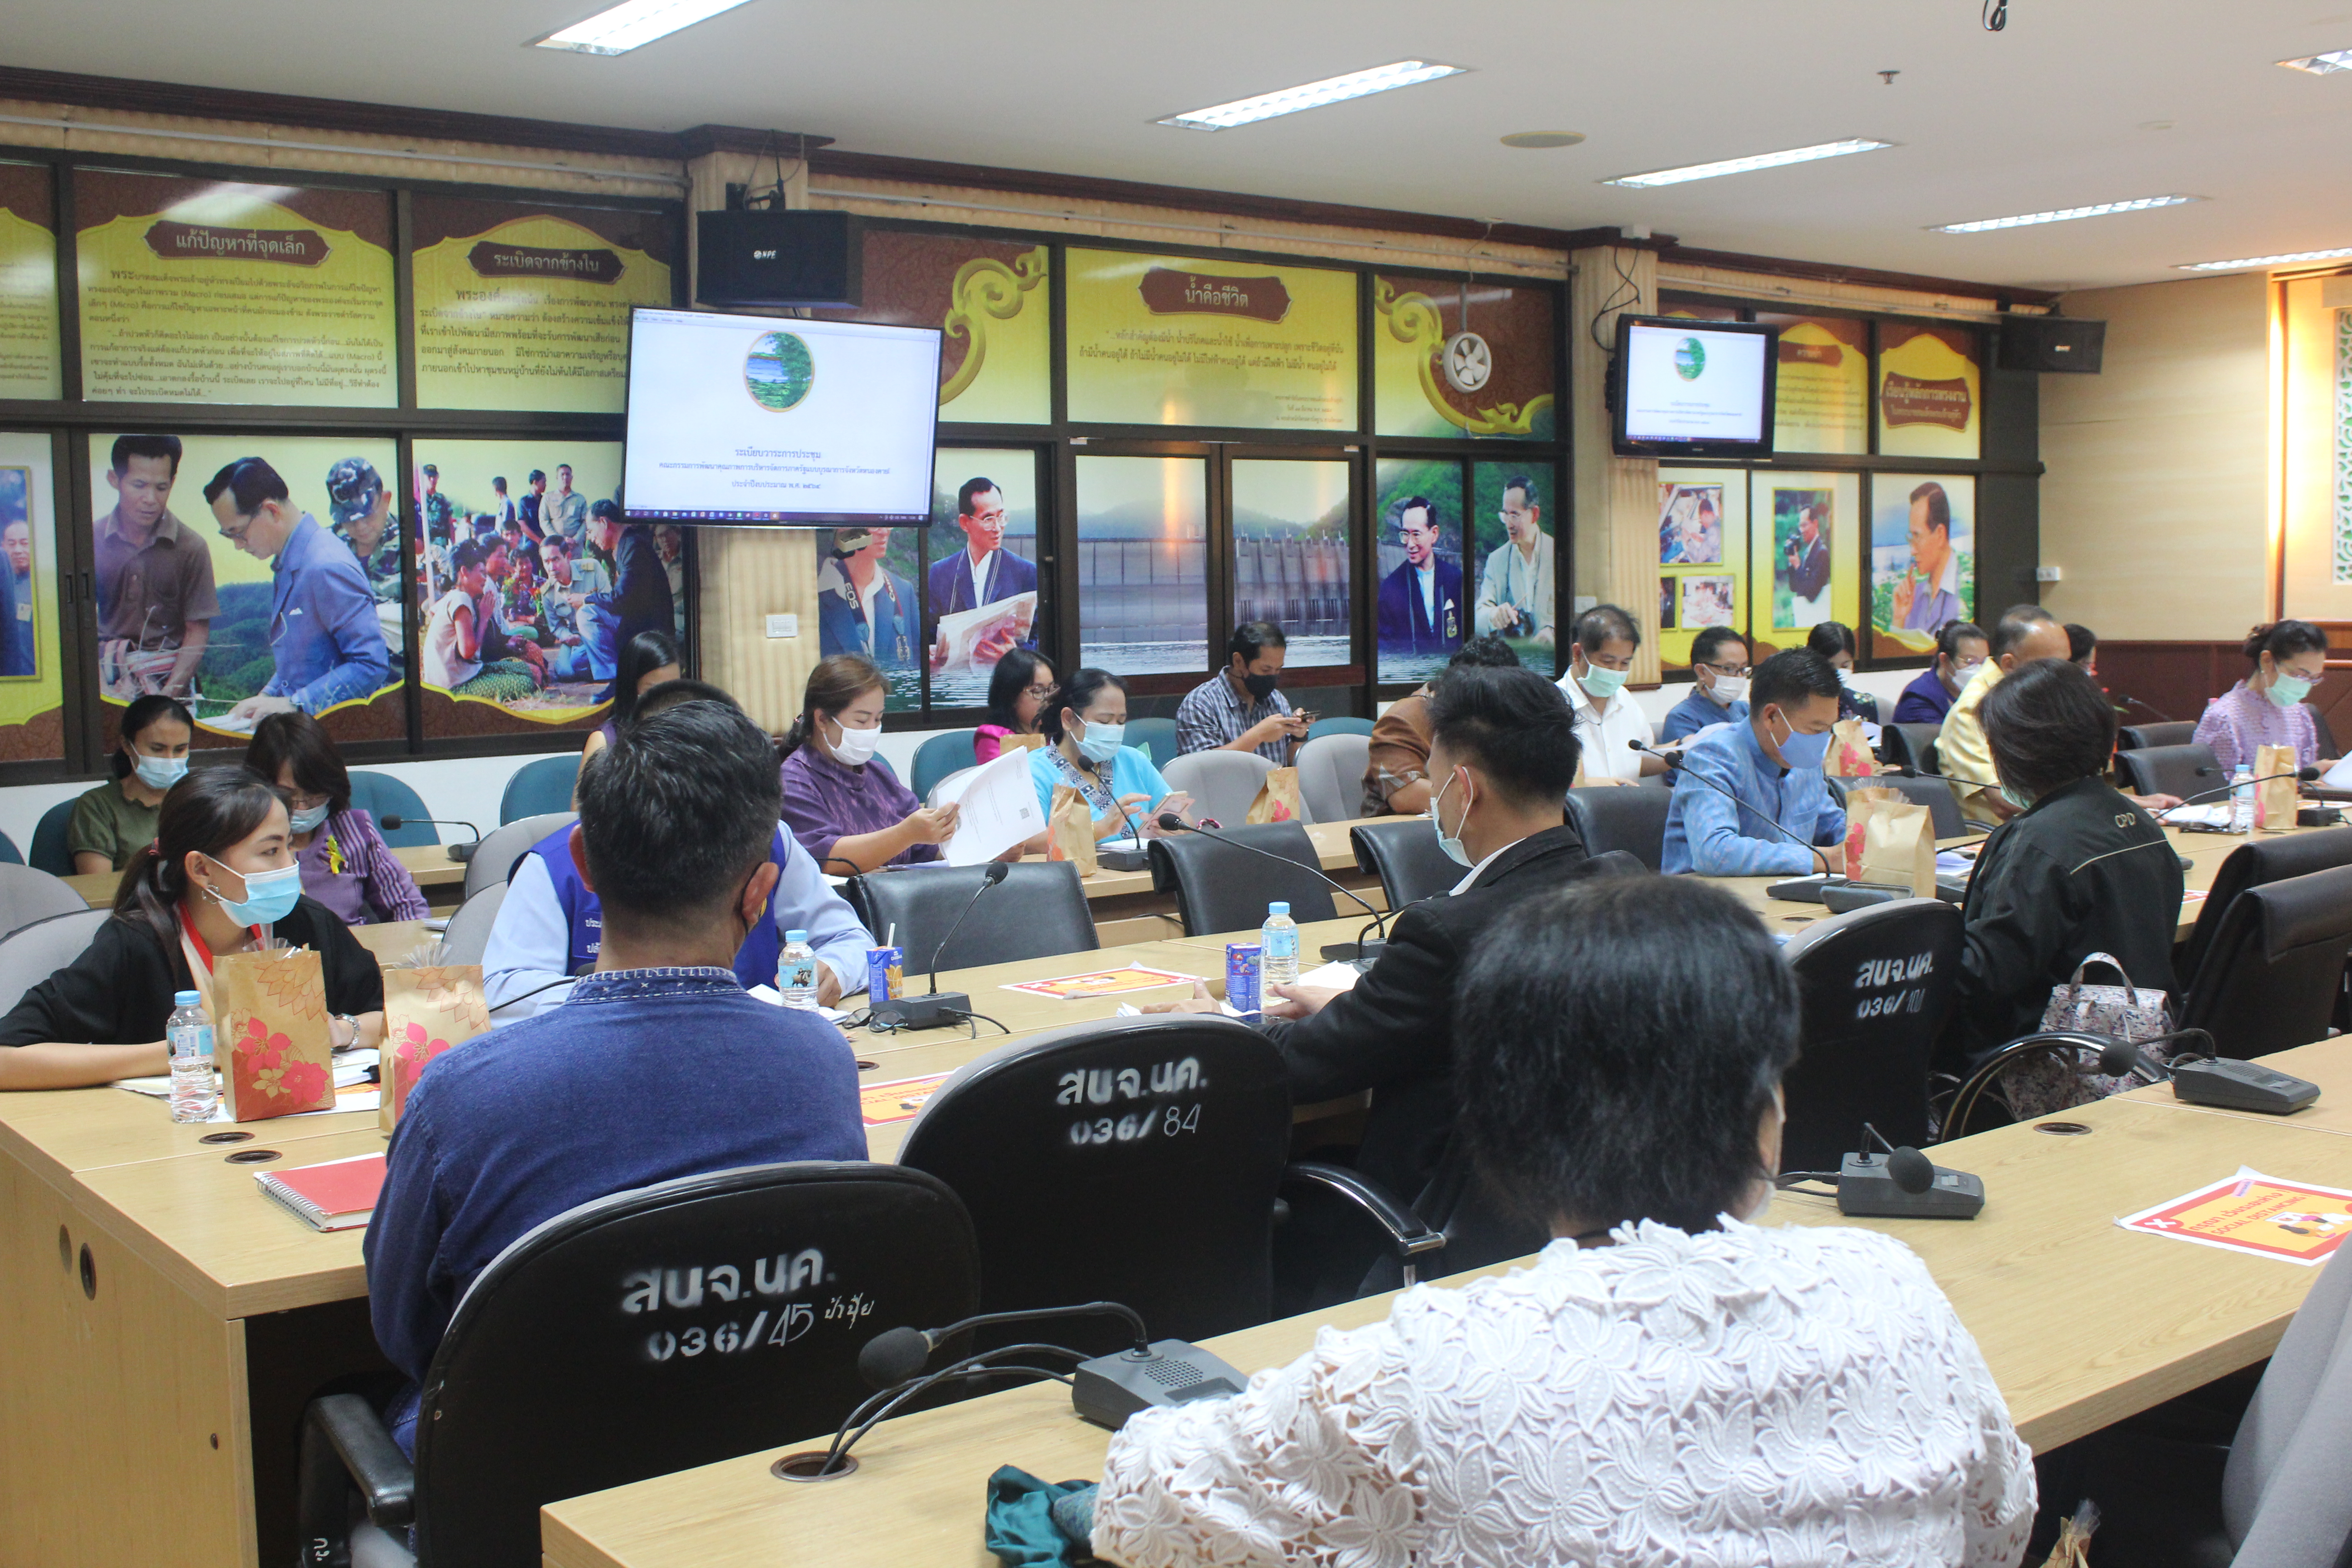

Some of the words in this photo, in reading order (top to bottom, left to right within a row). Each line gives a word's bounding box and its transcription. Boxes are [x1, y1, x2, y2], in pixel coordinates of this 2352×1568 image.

[176, 228, 305, 259] แก้ปัญหาที่จุดเล็ก
[762, 250, 776, 260] NPE
[494, 252, 599, 274] ระเบิดจากข้างใน
[1185, 276, 1249, 308] น้ำคือชีวิต
[735, 446, 821, 461] ระเบียบวาระการประชุม
[731, 478, 787, 489] ประจำปีงบประมาณ
[844, 582, 859, 610] EOS
[2114, 812, 2136, 828] CPD
[1854, 951, 1934, 988] สนจ.นค.
[1056, 1056, 1209, 1106] สนจ.นค.
[2210, 1220, 2252, 1235] SOCIAL
[2252, 1195, 2306, 1220] DISTANCING
[2220, 1190, 2284, 1221] เว้นระยะห่าง
[621, 1247, 836, 1315] สนจ.นค.
